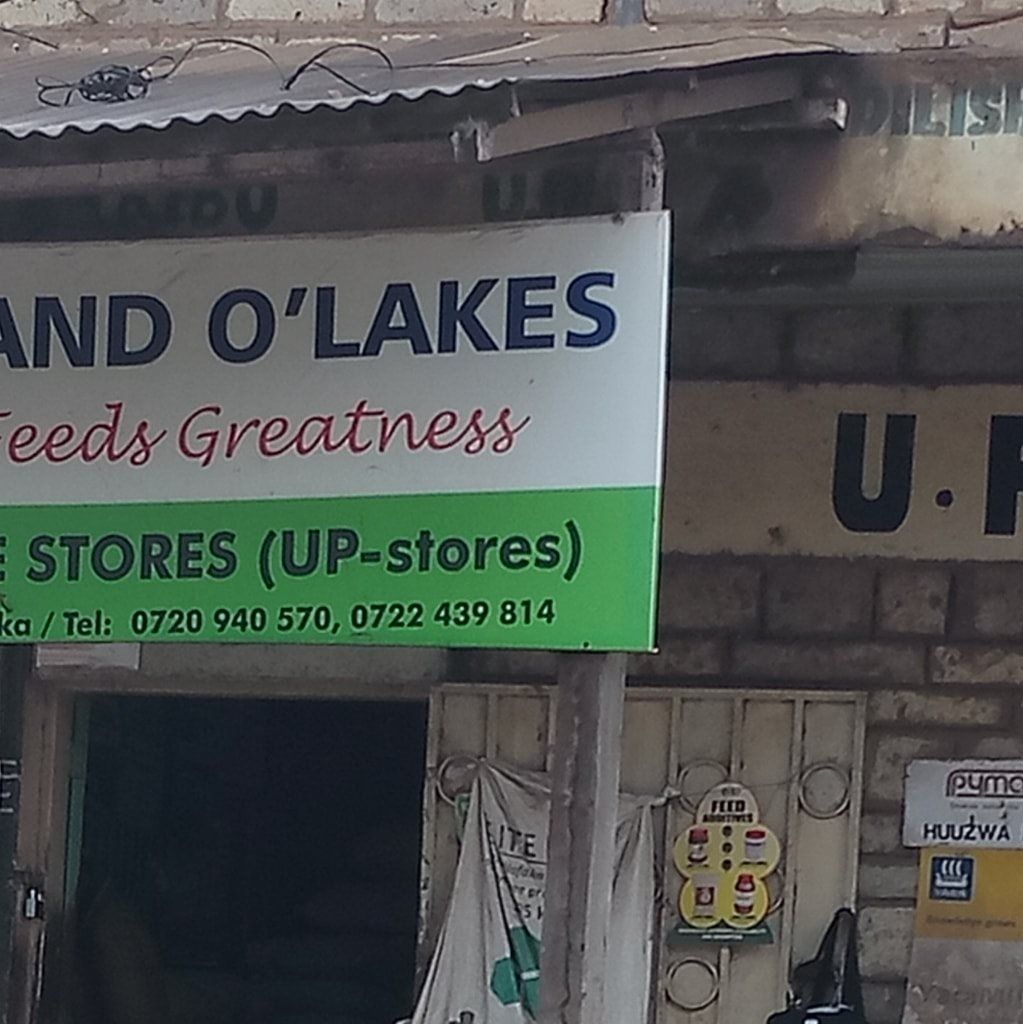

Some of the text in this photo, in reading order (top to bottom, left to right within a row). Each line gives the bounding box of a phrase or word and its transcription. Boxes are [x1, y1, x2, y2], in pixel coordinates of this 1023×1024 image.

[0, 400, 531, 467] eeds Greatness
[26, 532, 236, 582] STORES
[259, 520, 582, 589] (UP-stores)
[63, 610, 111, 636] Tel:
[131, 610, 202, 634] 0720
[213, 608, 268, 633] 940
[276, 606, 340, 635] 570,
[350, 604, 424, 630] 0722
[433, 601, 488, 627] 439
[500, 599, 556, 625] 814
[923, 823, 1010, 842] HUUZWA
